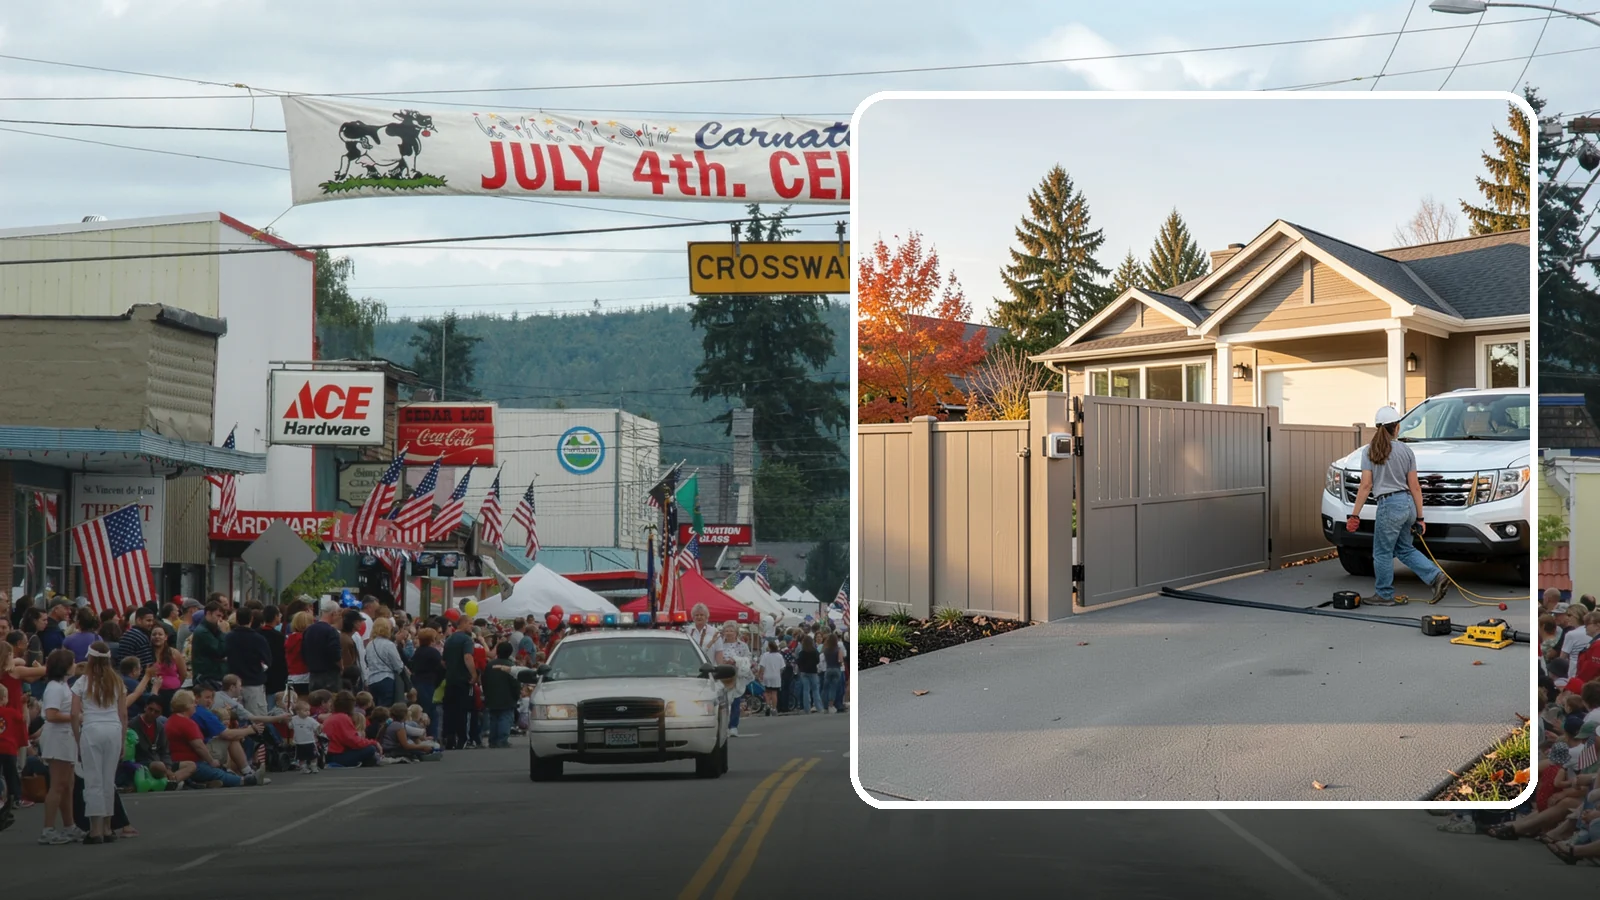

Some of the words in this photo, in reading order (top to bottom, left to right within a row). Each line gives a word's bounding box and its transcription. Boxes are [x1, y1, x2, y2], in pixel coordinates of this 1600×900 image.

[481, 141, 605, 192] JULY
[632, 150, 746, 198] 4th.
[697, 254, 850, 280] CROSSWA
[283, 380, 373, 419] ACE
[405, 409, 453, 422] CEDAR
[461, 409, 485, 421] LOG
[283, 421, 371, 436] Hardware
[416, 428, 476, 447] Coca-Cola
[353, 467, 383, 480] Simpl
[83, 486, 94, 494] St.
[95, 485, 124, 495] Vincent
[126, 486, 136, 495] de
[137, 485, 155, 496] Paul
[81, 503, 153, 521] THT
[688, 526, 741, 535] CRNATION
[699, 535, 730, 543] GLASS
